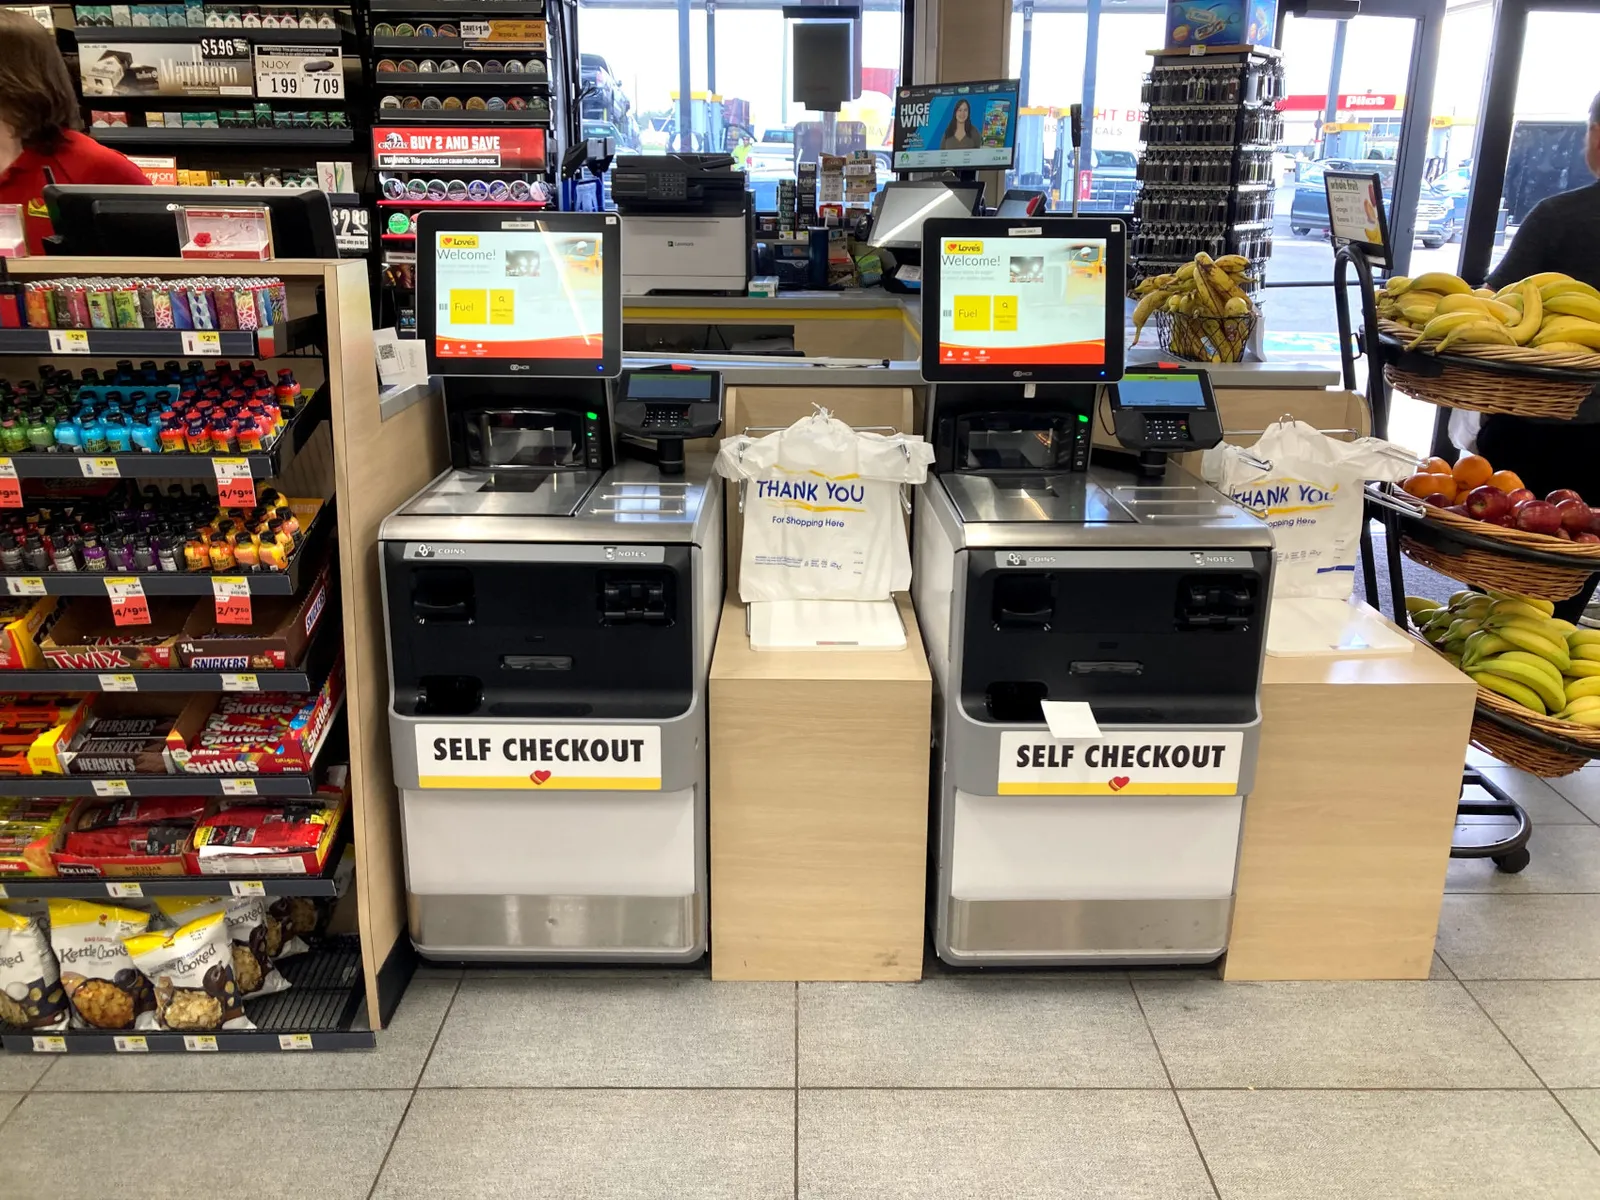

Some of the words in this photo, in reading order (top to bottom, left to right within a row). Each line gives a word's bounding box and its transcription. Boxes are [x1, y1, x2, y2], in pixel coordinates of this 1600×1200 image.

[262, 60, 291, 69] NJOY
[901, 103, 930, 115] HUGE
[901, 115, 929, 128] WIN!
[410, 136, 432, 150] BUY
[435, 136, 443, 150] 2
[446, 136, 468, 150] AND
[472, 136, 500, 150] SAVE
[420, 157, 439, 165] product
[453, 237, 476, 246] Love's
[958, 244, 980, 252] Love's
[437, 249, 496, 260] Welcome!
[942, 256, 1001, 266] Welcome!
[454, 302, 474, 312] Fuel
[958, 308, 977, 318] Fuel
[756, 480, 818, 501] THANK
[825, 481, 864, 503] YOU
[1232, 486, 1290, 509] THANK
[772, 515, 785, 524] For
[786, 516, 824, 528] Shopping
[825, 520, 845, 528] Here
[1267, 518, 1295, 529] opping
[1297, 517, 1317, 526] Here
[438, 547, 466, 555] COINS
[181, 643, 194, 653] 24
[193, 658, 247, 669] SNICKERS
[223, 702, 293, 714] Skittles
[95, 719, 156, 733] HERSHEY'S
[307, 697, 332, 753] Skittles
[83, 740, 146, 753] HERSHEY'S
[433, 737, 491, 761] SELF
[502, 738, 644, 762] CHECKOUT
[1016, 744, 1074, 768] SELF
[1084, 744, 1226, 768] CHECKOUT
[77, 757, 136, 771] HERSHEY'S
[184, 758, 260, 774] Skittles
[60, 946, 97, 963] Kettle
[176, 943, 217, 974] Cooked
